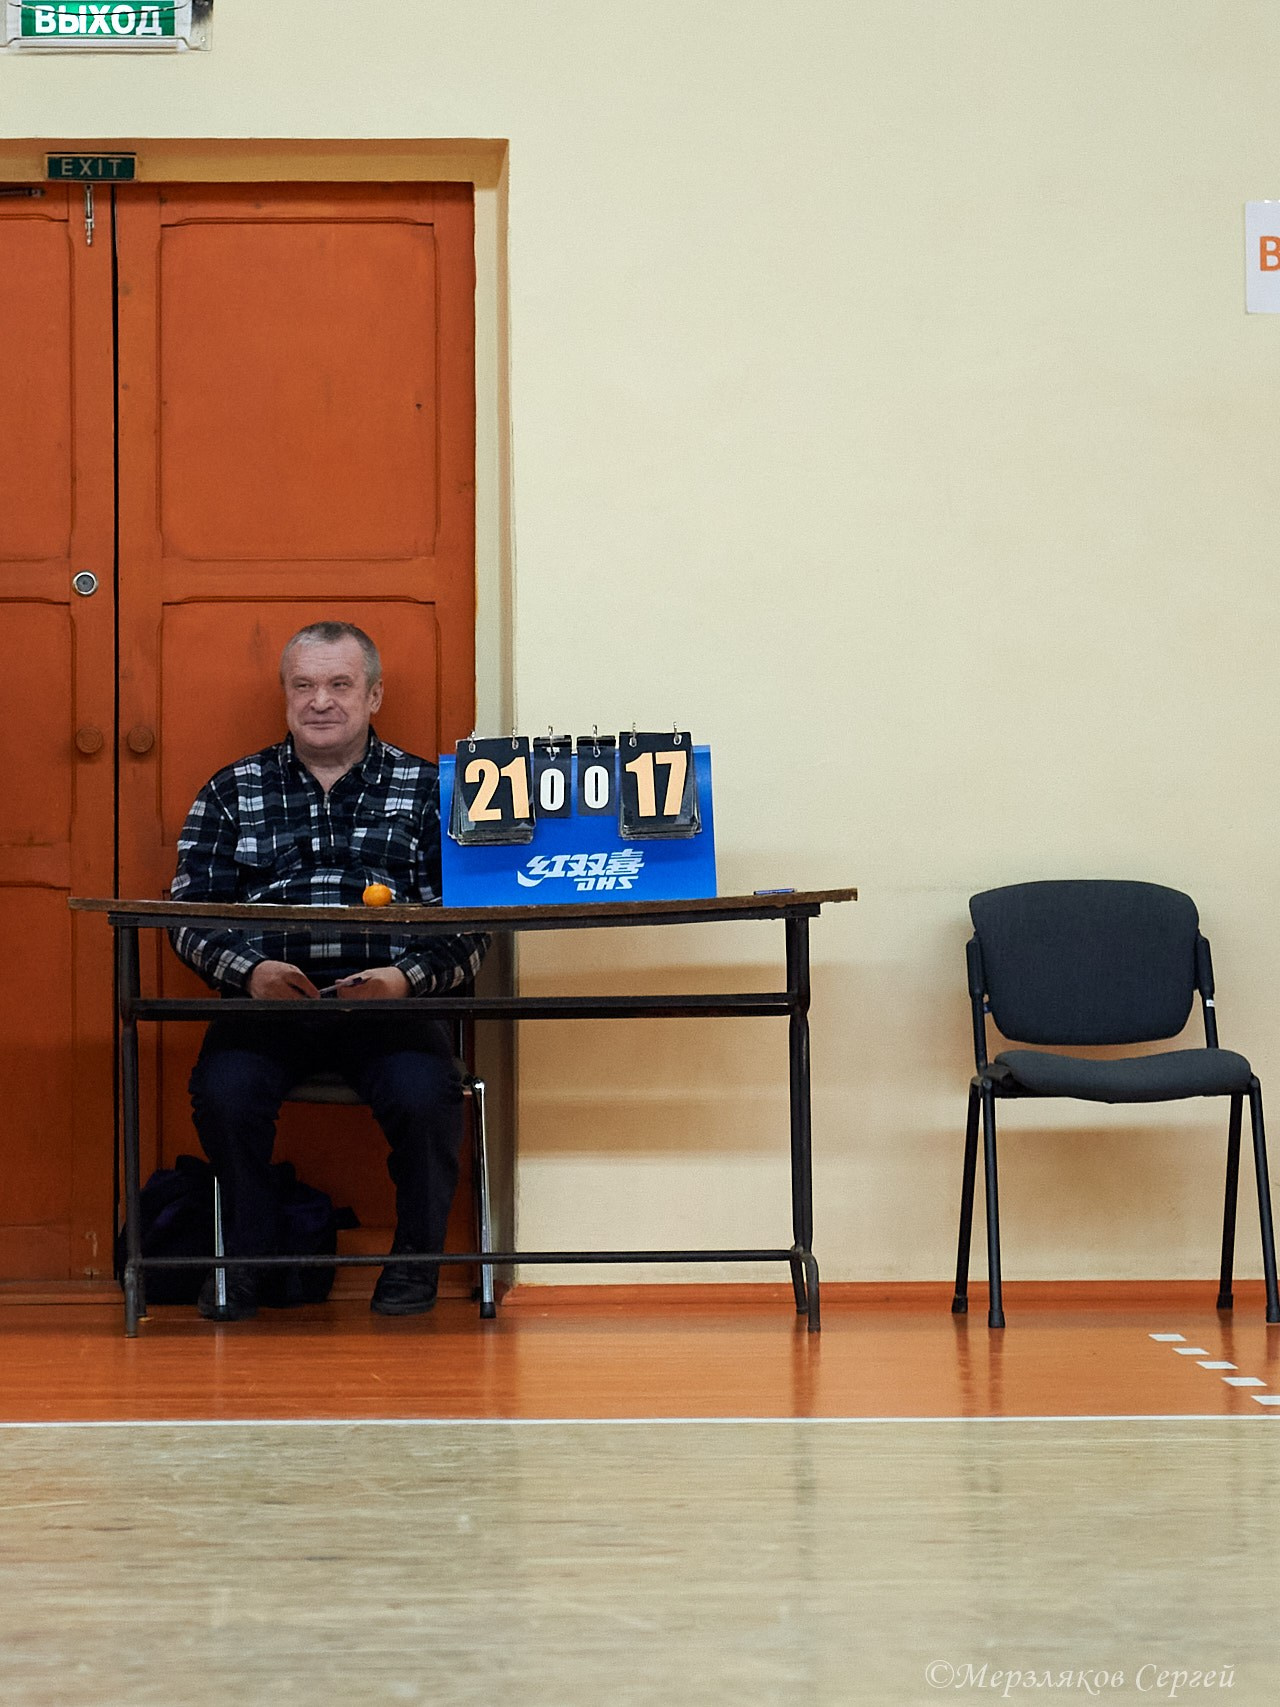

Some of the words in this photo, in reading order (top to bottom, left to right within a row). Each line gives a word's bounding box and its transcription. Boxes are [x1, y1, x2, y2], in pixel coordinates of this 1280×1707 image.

[34, 4, 163, 36] ВЫХОД
[61, 159, 122, 176] EXIT
[464, 756, 530, 822] 21
[540, 768, 565, 811] 0
[584, 765, 609, 809] 0
[625, 750, 687, 817] 17
[517, 848, 645, 888] 红双喜
[574, 875, 639, 891] DHS
